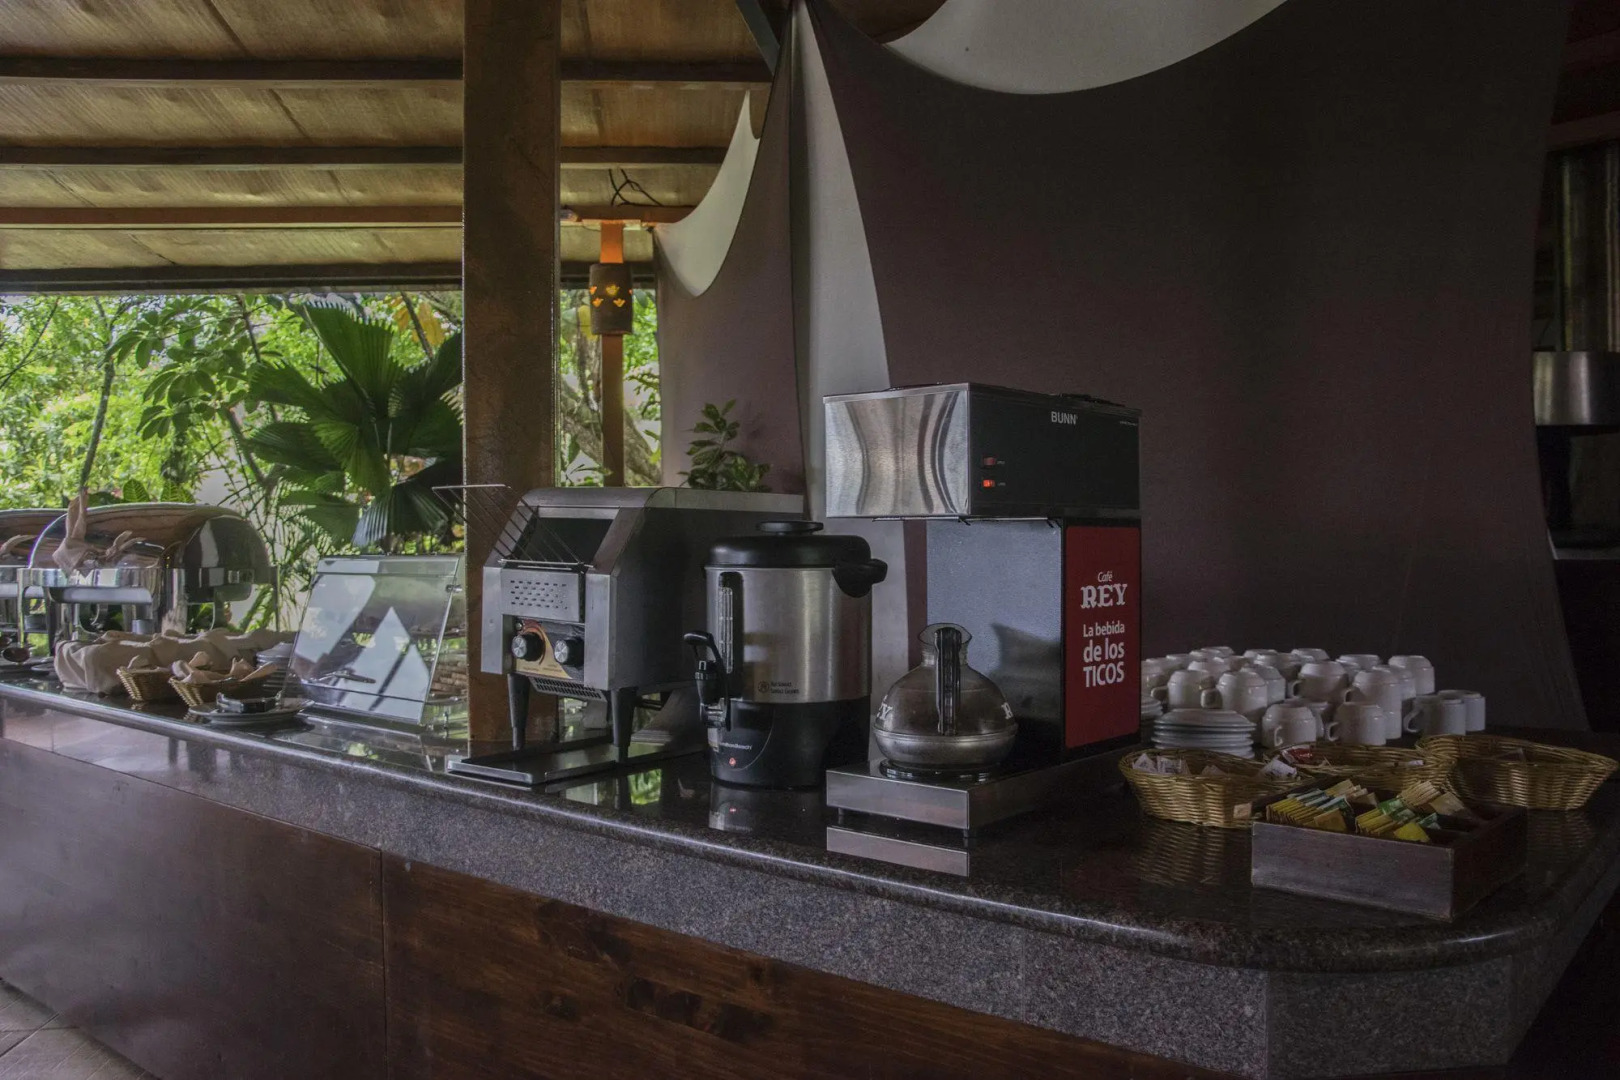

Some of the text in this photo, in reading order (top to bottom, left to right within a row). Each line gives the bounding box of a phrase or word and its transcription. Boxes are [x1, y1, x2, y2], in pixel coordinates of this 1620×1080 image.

[1051, 411, 1077, 425] BUNN
[1097, 572, 1113, 582] Café
[1080, 584, 1128, 609] REY
[1083, 620, 1125, 637] La bebida
[1083, 637, 1125, 663] de los
[1083, 661, 1125, 688] TICOS
